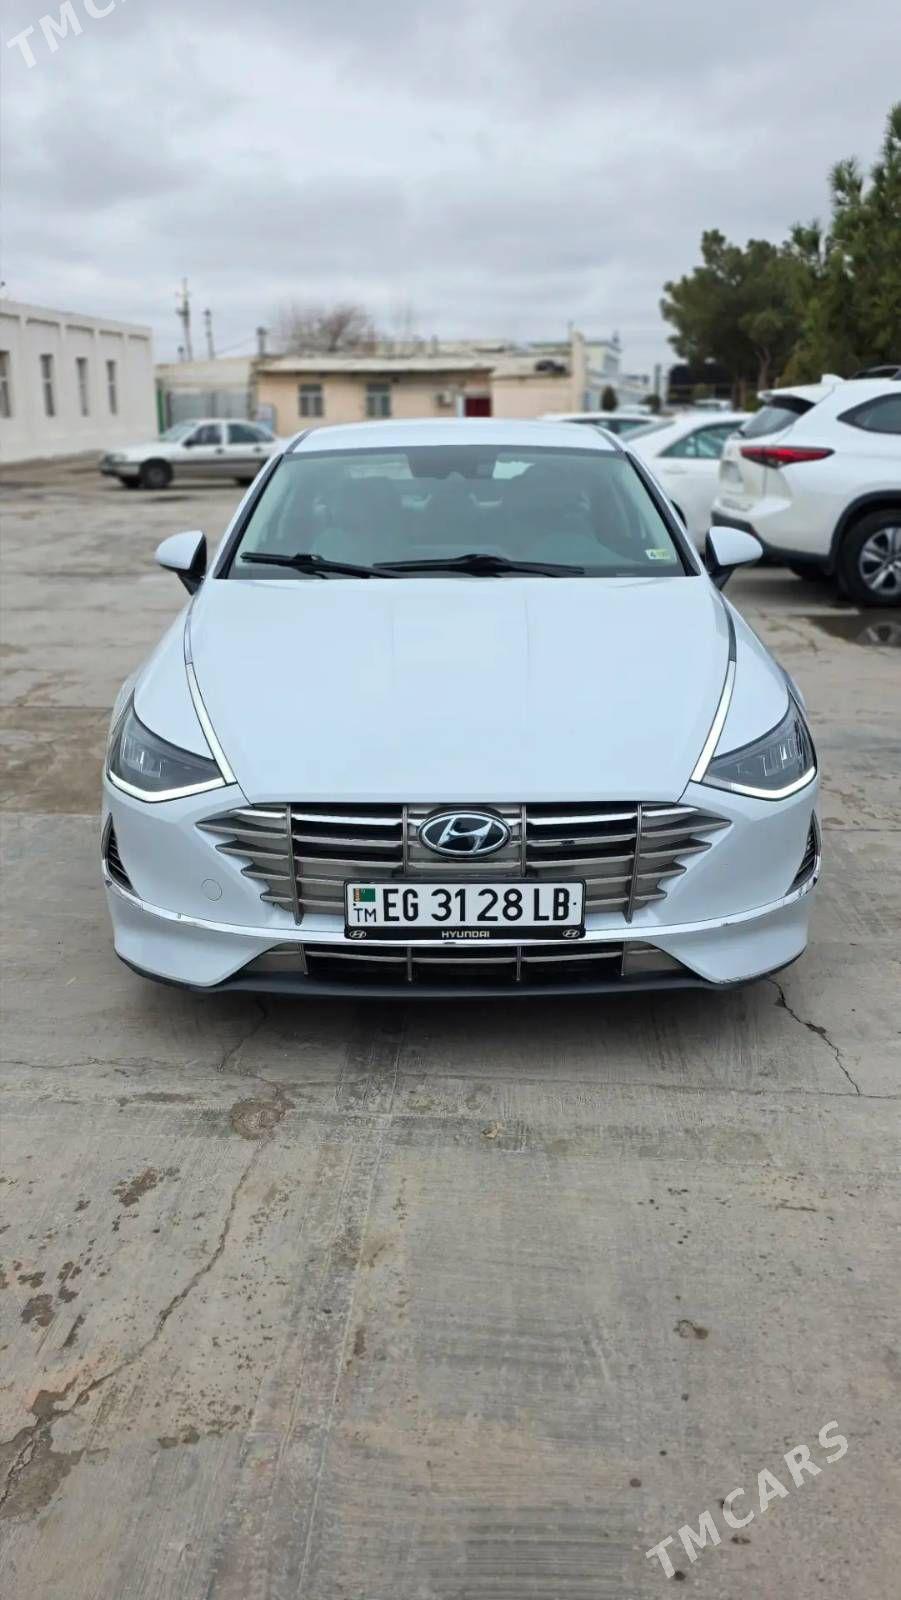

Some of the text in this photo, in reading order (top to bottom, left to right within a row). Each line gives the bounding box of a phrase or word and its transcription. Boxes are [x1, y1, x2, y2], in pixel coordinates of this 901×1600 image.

[382, 888, 419, 922] EG
[533, 887, 570, 921] LB
[353, 907, 377, 923] TM
[441, 930, 490, 938] HYUNDAI
